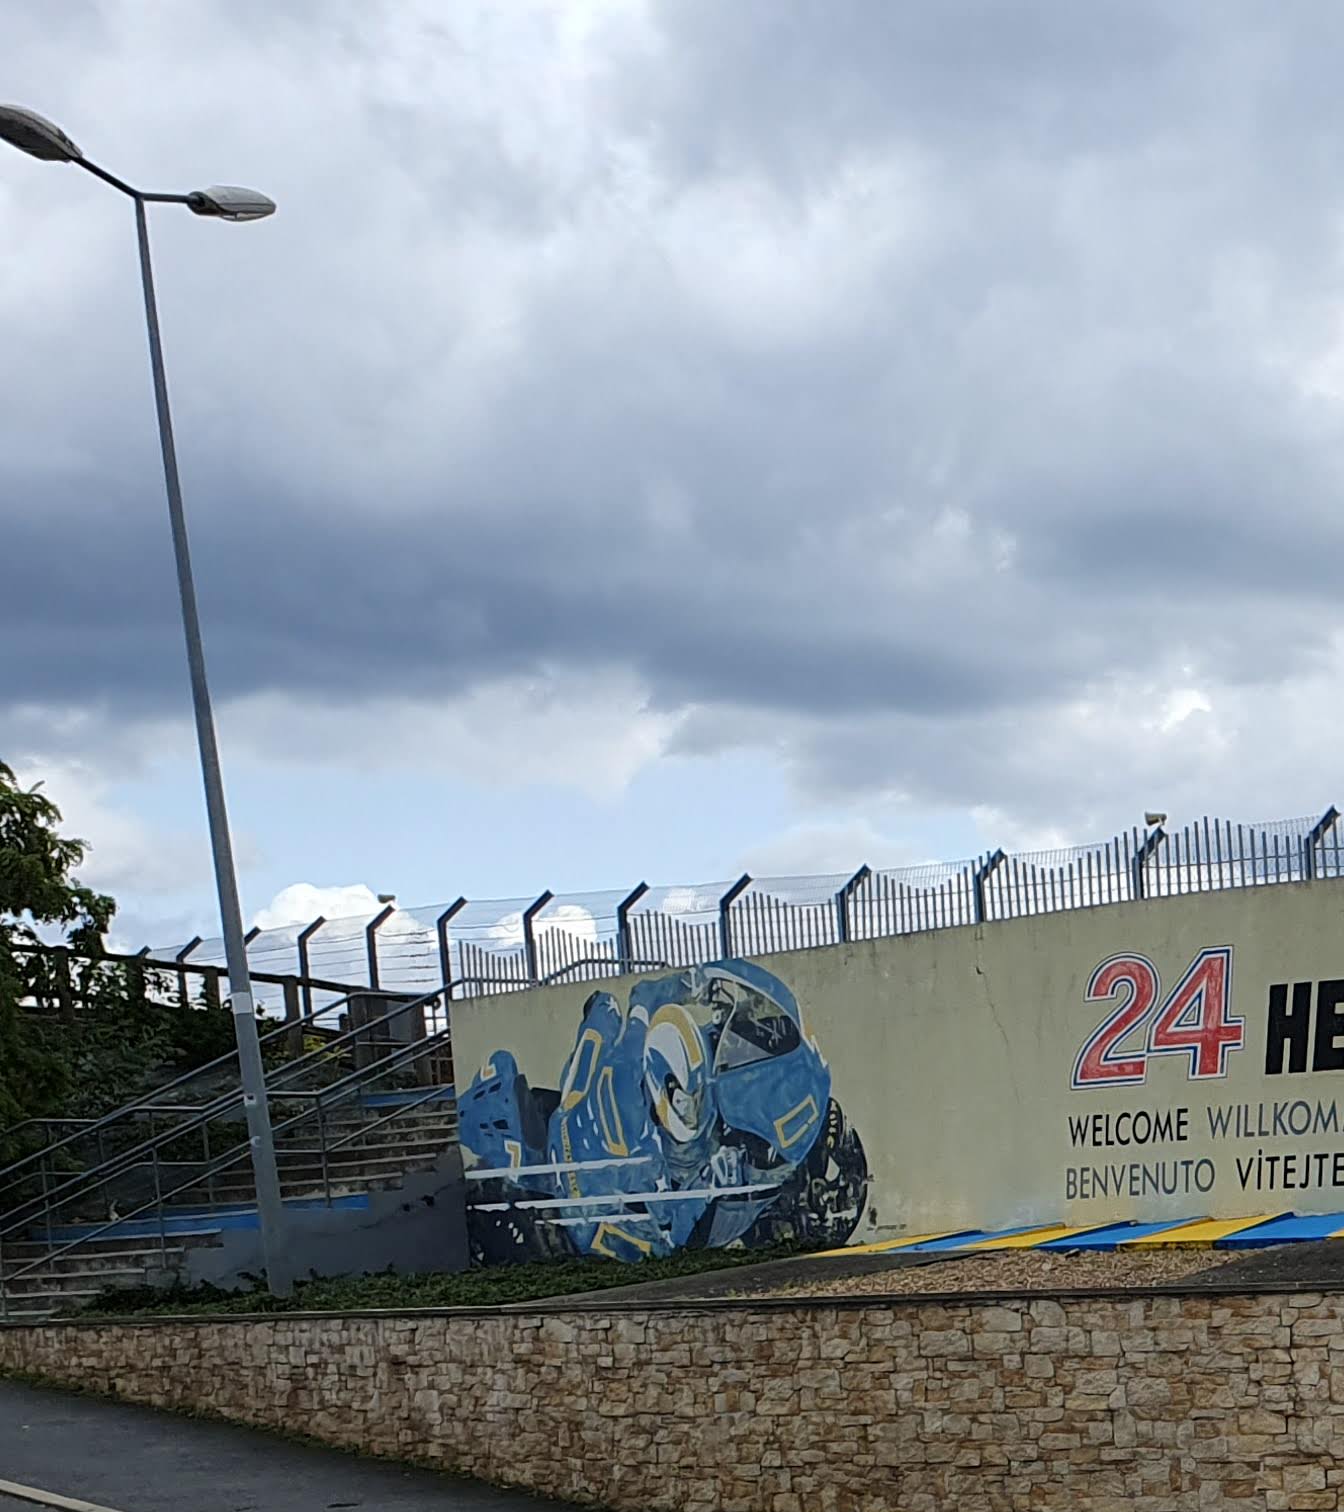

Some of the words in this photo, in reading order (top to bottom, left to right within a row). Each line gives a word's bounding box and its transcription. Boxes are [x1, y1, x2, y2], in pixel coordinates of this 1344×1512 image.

[1071, 945, 1246, 1090] 24
[1069, 1107, 1189, 1147] WELCOME
[1066, 1158, 1215, 1199] BENVENUTO
